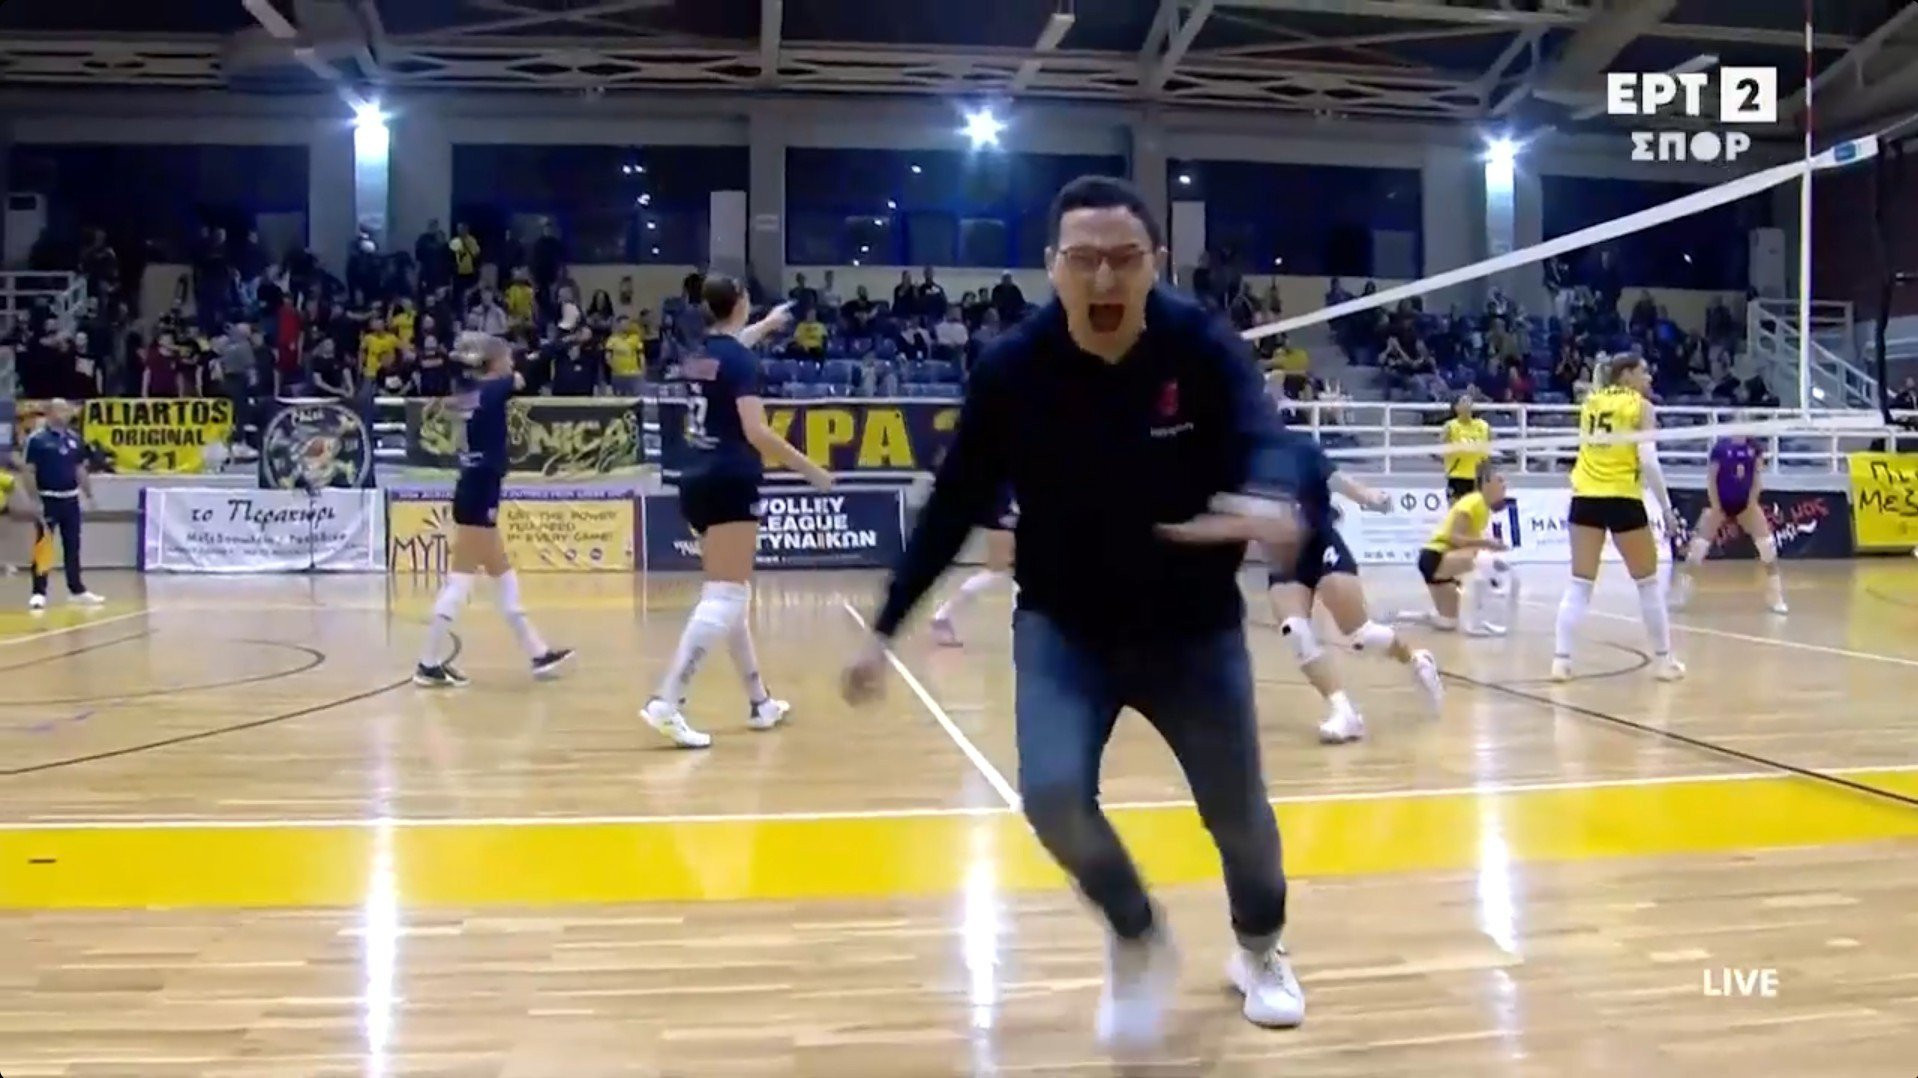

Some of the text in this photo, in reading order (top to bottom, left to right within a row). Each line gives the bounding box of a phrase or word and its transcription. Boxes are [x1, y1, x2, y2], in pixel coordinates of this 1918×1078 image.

[88, 400, 229, 425] ALIARTOS
[1588, 411, 1614, 435] 15
[110, 428, 206, 446] ORIGINAL
[139, 451, 178, 470] 21
[757, 497, 845, 515] VOLLEY
